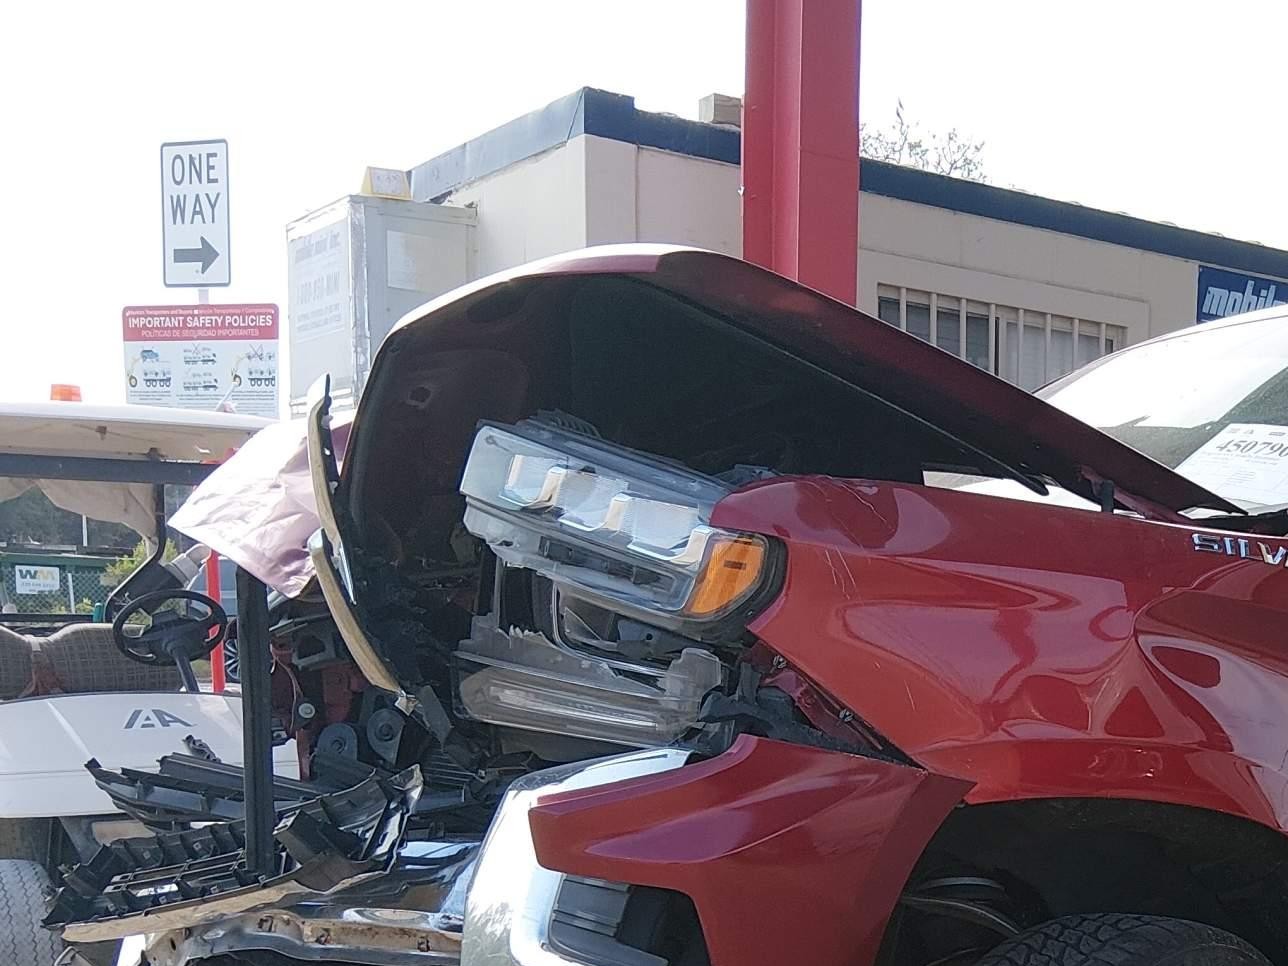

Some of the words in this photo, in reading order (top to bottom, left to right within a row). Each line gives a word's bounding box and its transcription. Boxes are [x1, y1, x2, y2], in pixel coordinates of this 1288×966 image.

[171, 152, 219, 186] ONE
[170, 192, 221, 225] WAY
[1202, 280, 1287, 317] mobil
[128, 316, 184, 328] IMPORTANT
[186, 315, 223, 328] SAFETY
[225, 314, 273, 327] POLICIES
[173, 329, 180, 337] DE
[217, 328, 260, 337] IMPORTANTES
